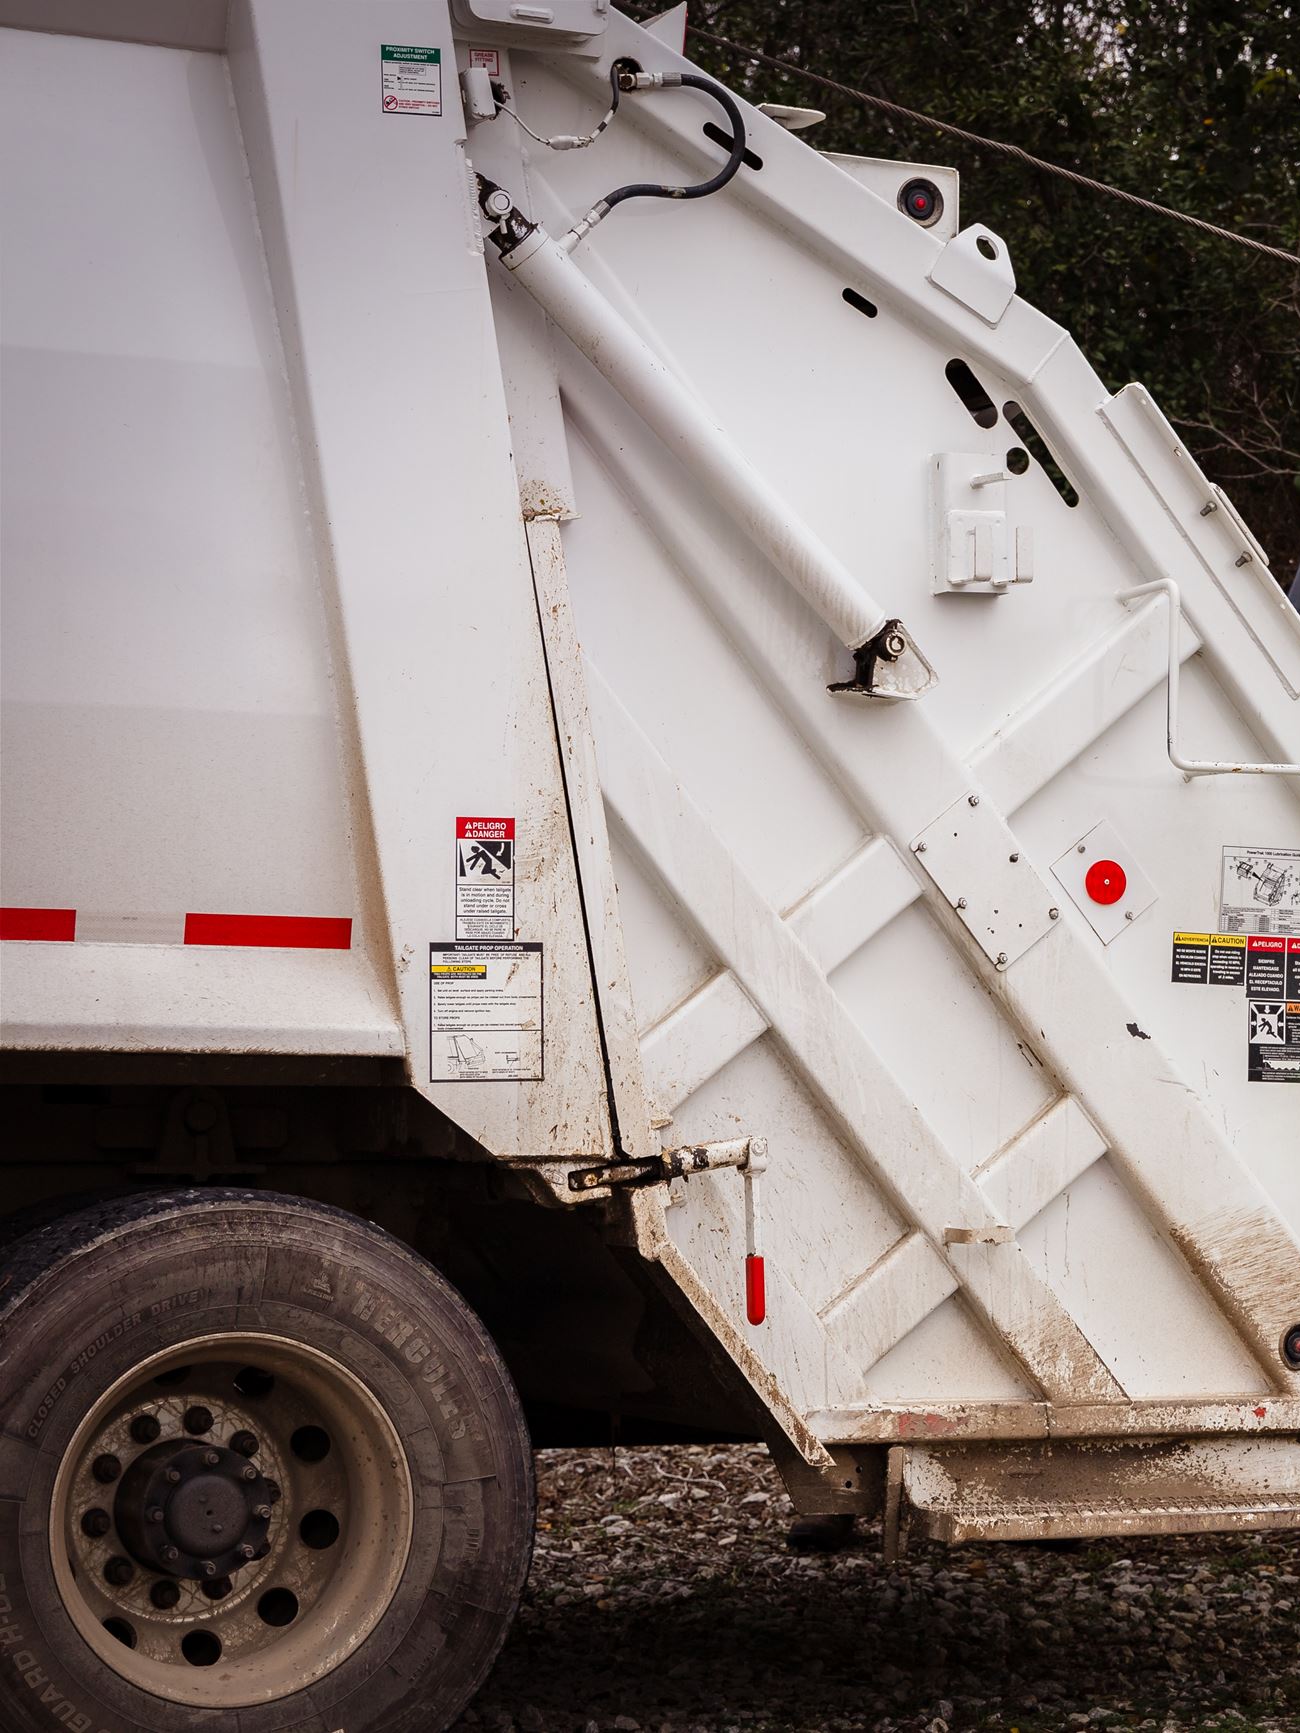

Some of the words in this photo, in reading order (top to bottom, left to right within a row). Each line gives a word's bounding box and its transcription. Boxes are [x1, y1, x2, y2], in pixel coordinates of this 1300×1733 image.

[472, 822, 507, 830] PELIGRO
[472, 830, 505, 838] DANGER
[27, 1377, 67, 1438] CLOSED
[70, 1312, 142, 1375] SHOULDER
[151, 1290, 199, 1316] DRIVE
[352, 1289, 484, 1441] HERCULES
[13, 1649, 111, 1733] GUARD
